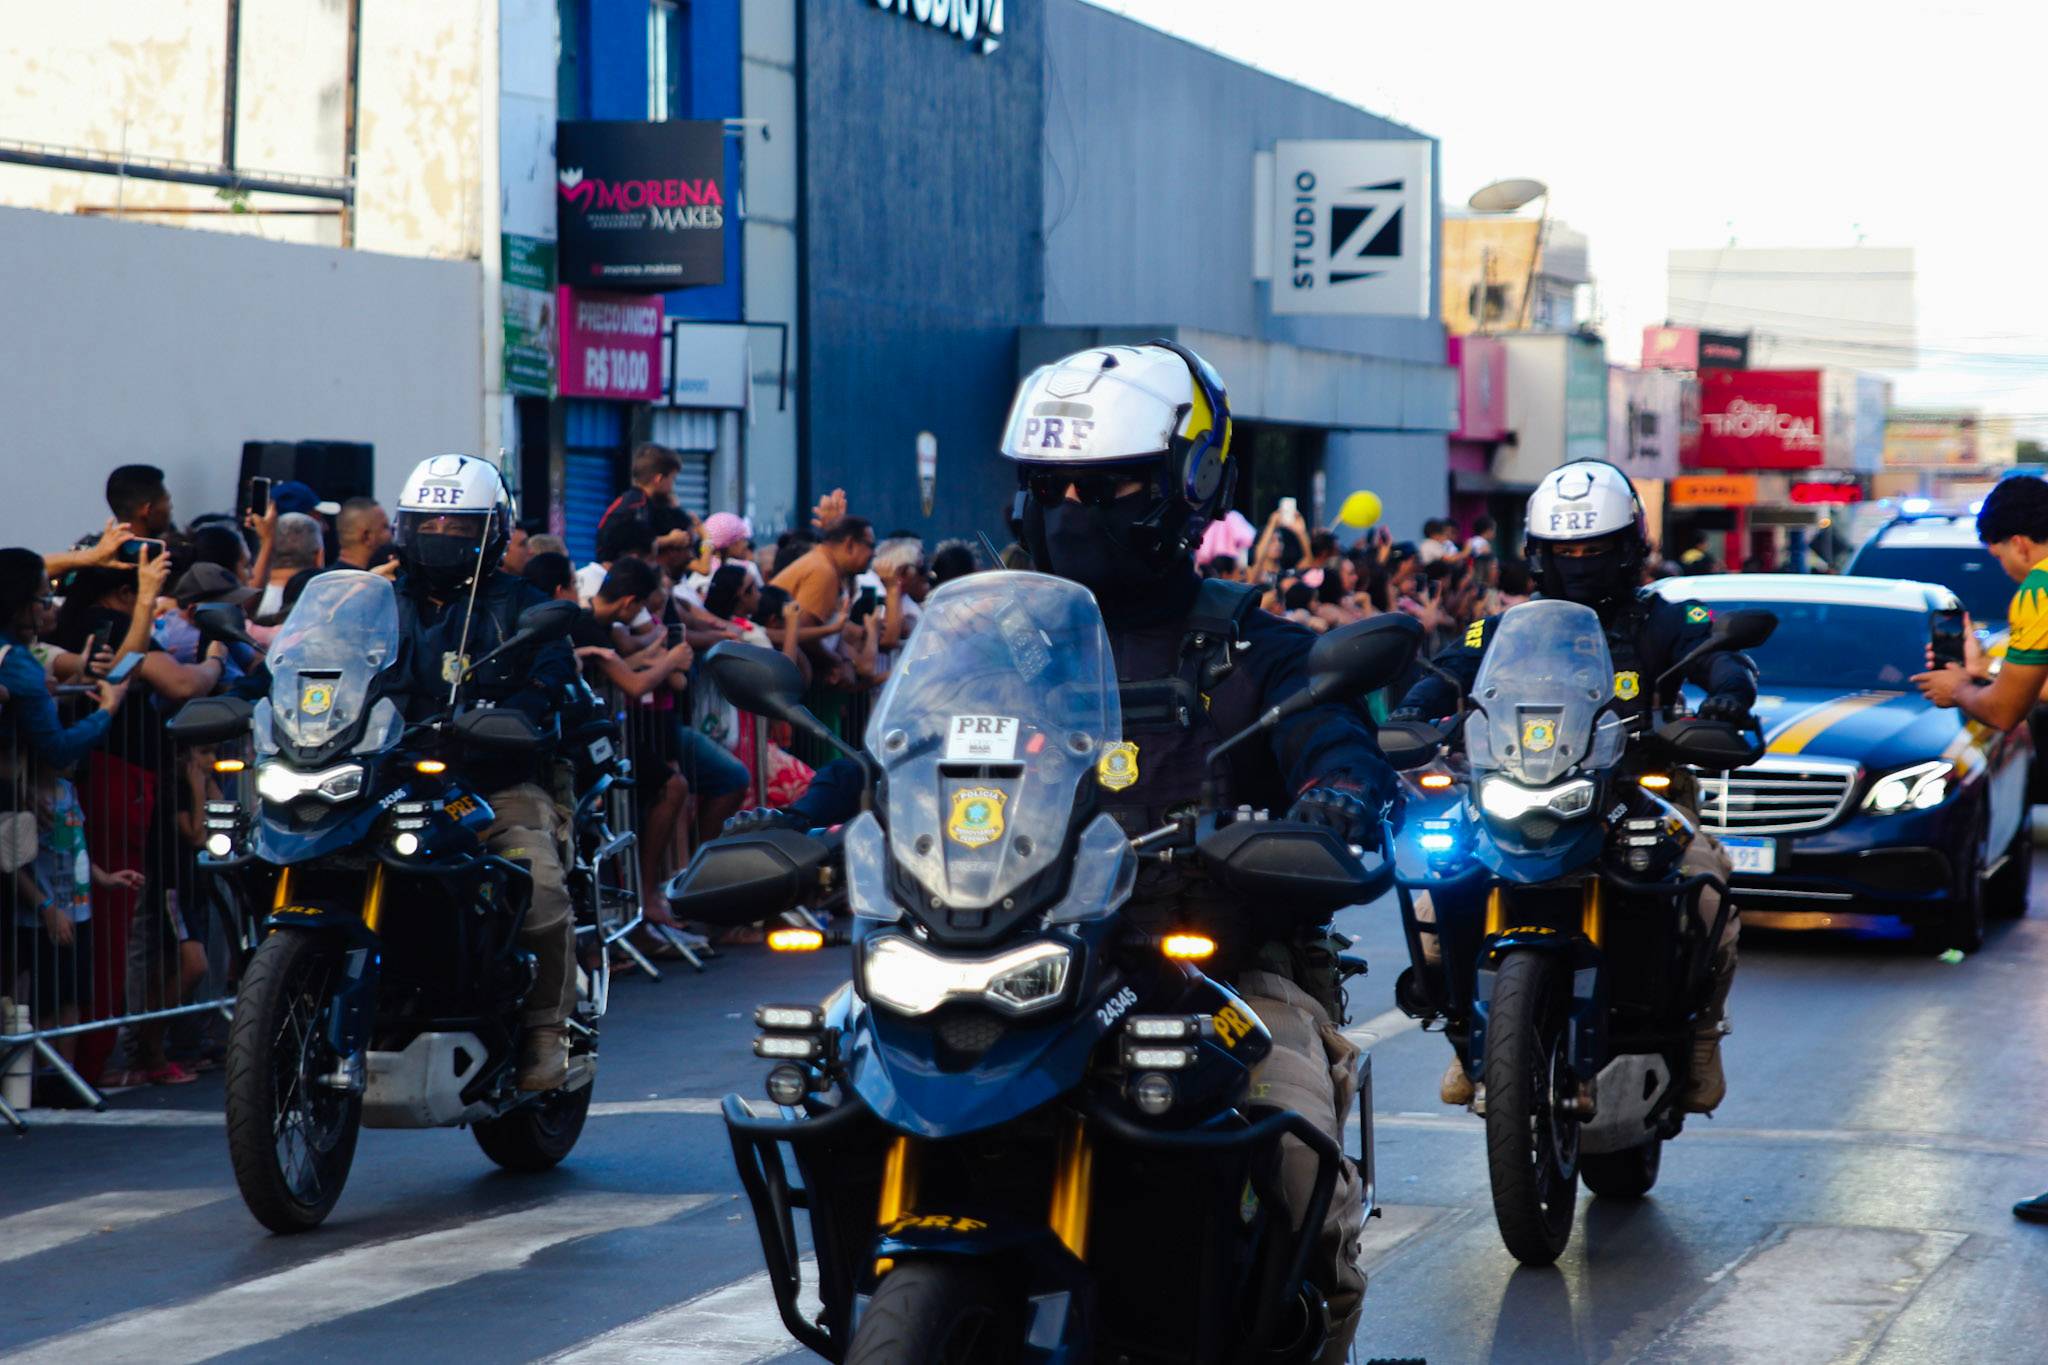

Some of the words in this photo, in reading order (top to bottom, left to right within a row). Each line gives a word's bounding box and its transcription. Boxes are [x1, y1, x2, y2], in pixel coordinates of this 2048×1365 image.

[596, 179, 723, 212] MORENA
[651, 205, 723, 232] MAKES
[1294, 172, 1315, 288] STUDIO
[1022, 418, 1095, 450] PRF
[1701, 413, 1815, 438] TROPICAL
[417, 487, 465, 504] PRF
[957, 717, 1011, 734] PRF
[443, 796, 477, 822] PRF
[1097, 986, 1138, 1027] 24345
